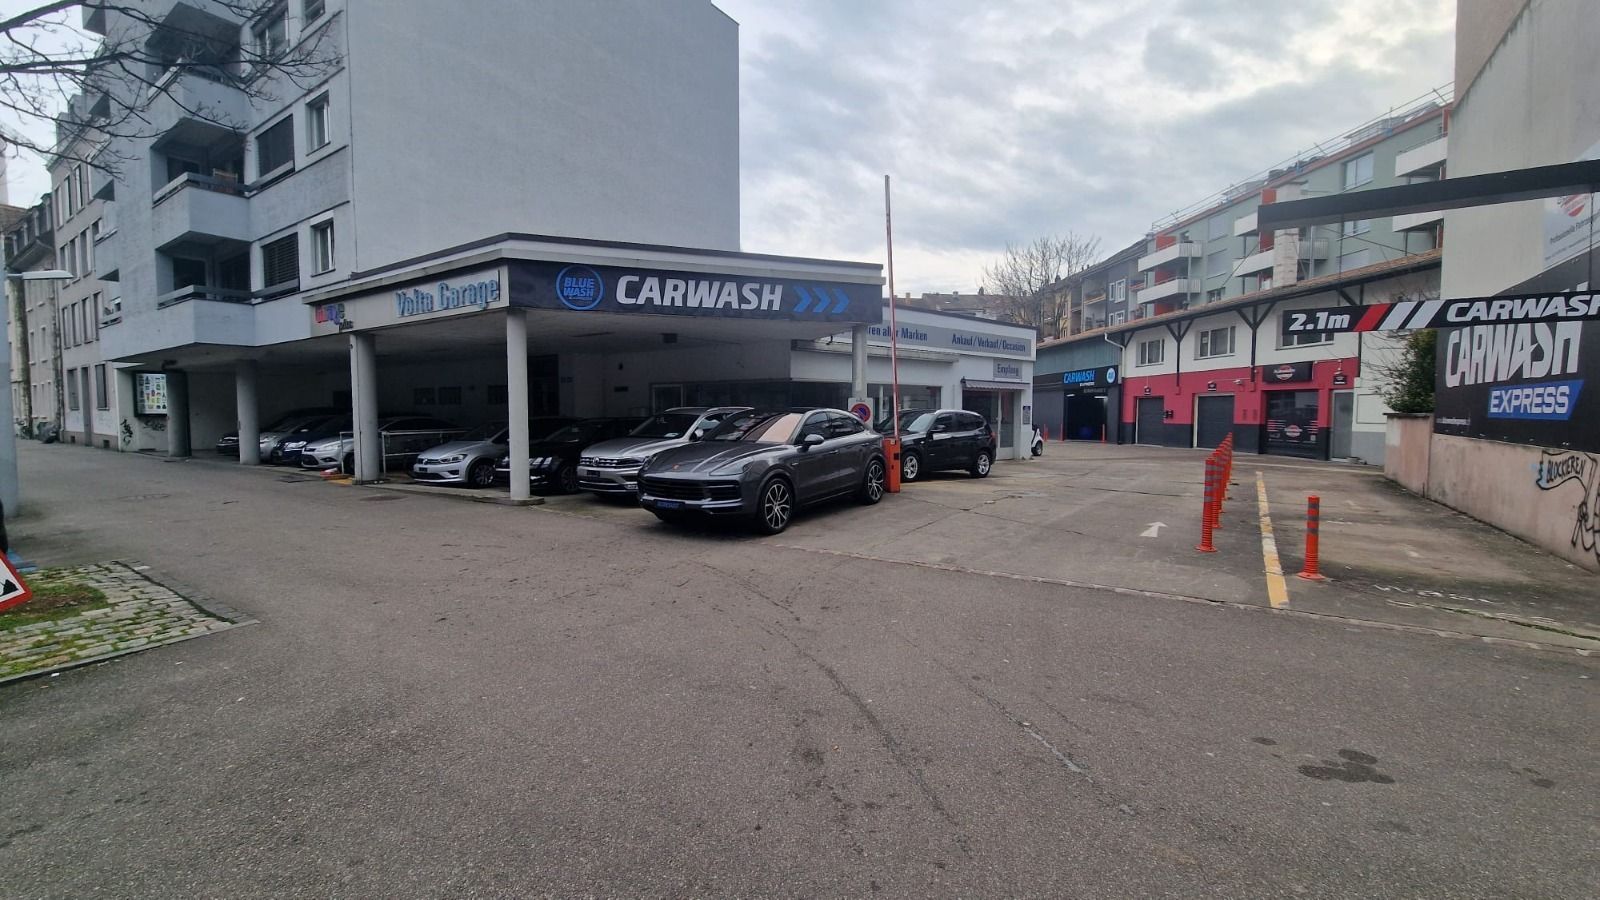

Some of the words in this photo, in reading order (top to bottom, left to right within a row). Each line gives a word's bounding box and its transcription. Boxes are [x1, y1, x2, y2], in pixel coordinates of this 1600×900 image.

[563, 287, 594, 297] WASH
[564, 277, 595, 288] BLUE
[395, 289, 433, 317] Volta
[435, 279, 498, 310] Garage
[616, 275, 783, 311] CARWASH
[1288, 311, 1351, 331] 2.1m
[882, 326, 899, 337] allr
[901, 327, 928, 341] Marken
[1444, 282, 1588, 388] CARWASH
[1063, 370, 1095, 384] CARWASH
[1490, 386, 1570, 414] EXPRESS
